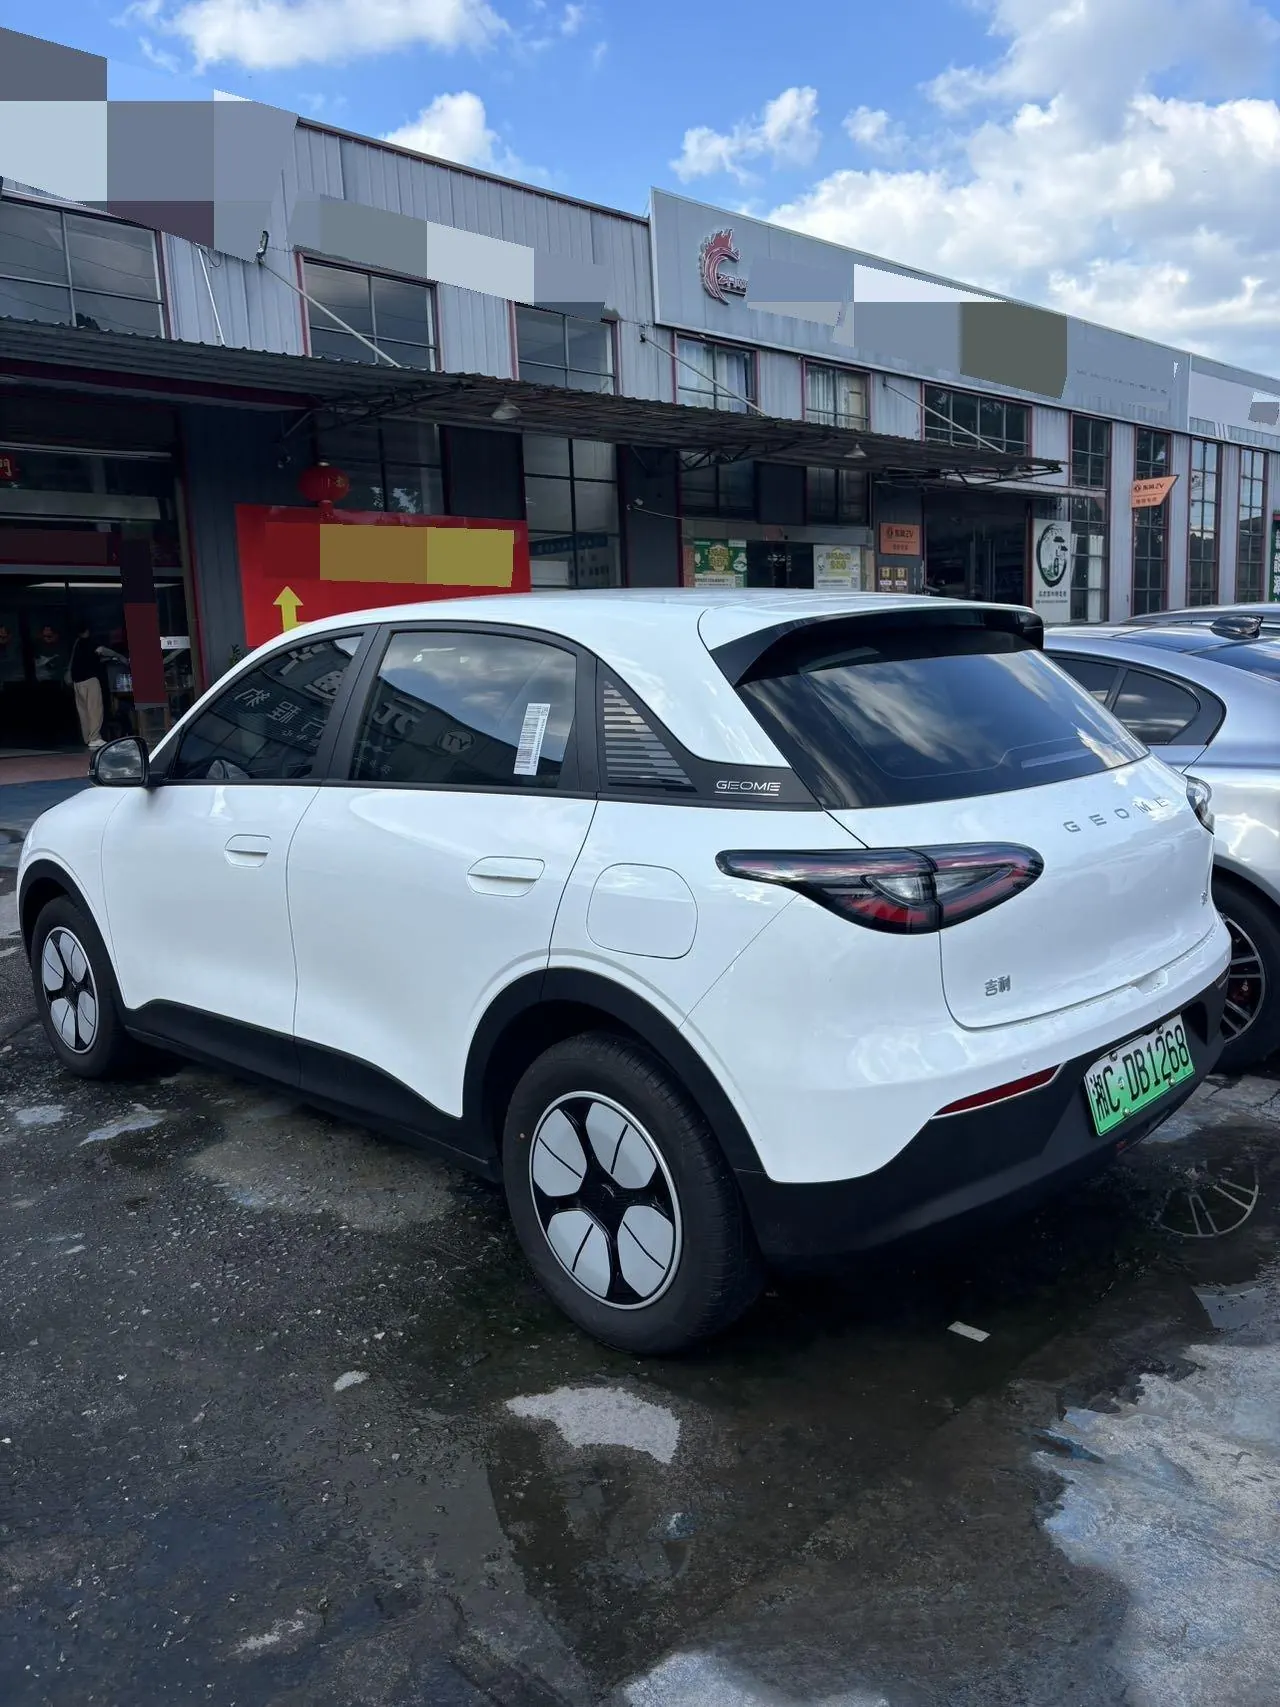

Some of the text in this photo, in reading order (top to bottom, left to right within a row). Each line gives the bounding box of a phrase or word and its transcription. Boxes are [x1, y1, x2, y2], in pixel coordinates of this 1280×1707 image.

[715, 780, 782, 792] GEOME
[1063, 796, 1168, 833] GEOME
[984, 974, 1011, 997] 吉利
